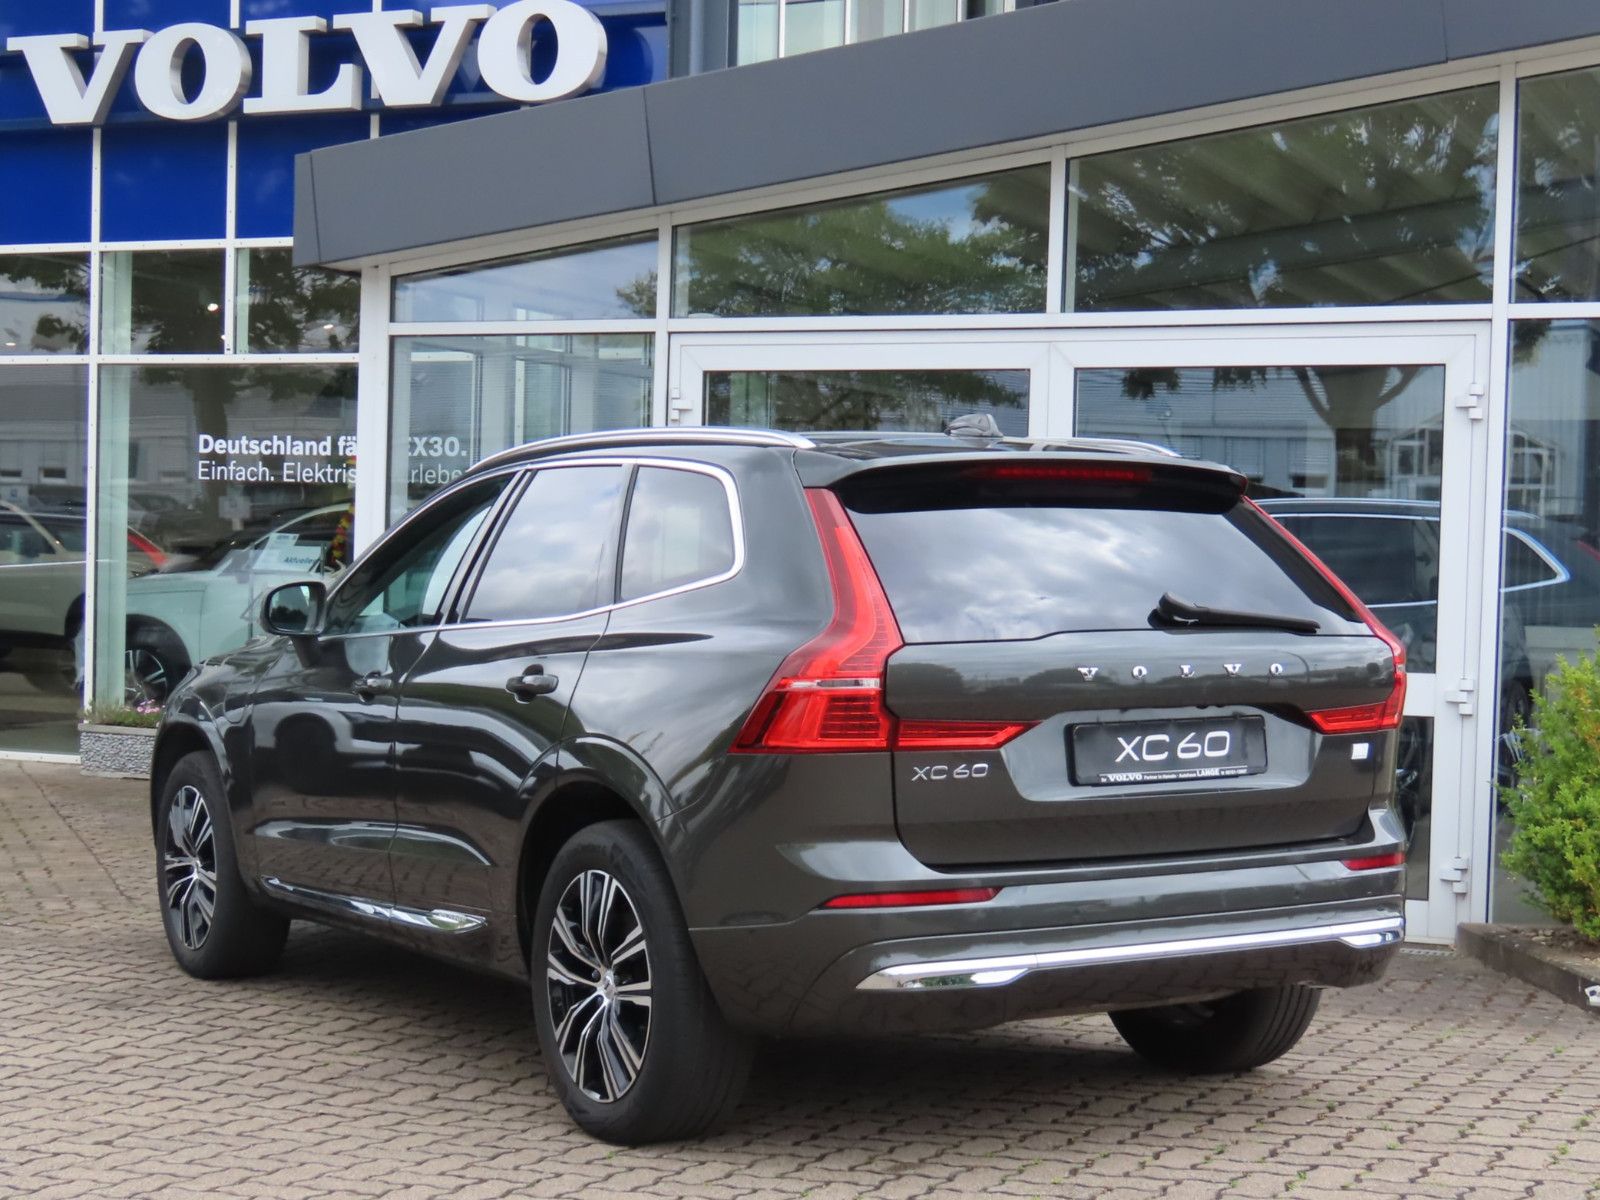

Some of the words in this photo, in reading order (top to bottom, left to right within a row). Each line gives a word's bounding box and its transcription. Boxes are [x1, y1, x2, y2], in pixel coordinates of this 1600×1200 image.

[7, 0, 608, 124] VOLVO
[199, 434, 331, 457] Deutschland
[337, 435, 358, 457] fä
[198, 460, 275, 482] Einfach.
[282, 462, 358, 484] Elektris
[409, 463, 463, 485] rlebe
[1077, 663, 1284, 682] VOLVO
[1108, 772, 1143, 782] VOLVO
